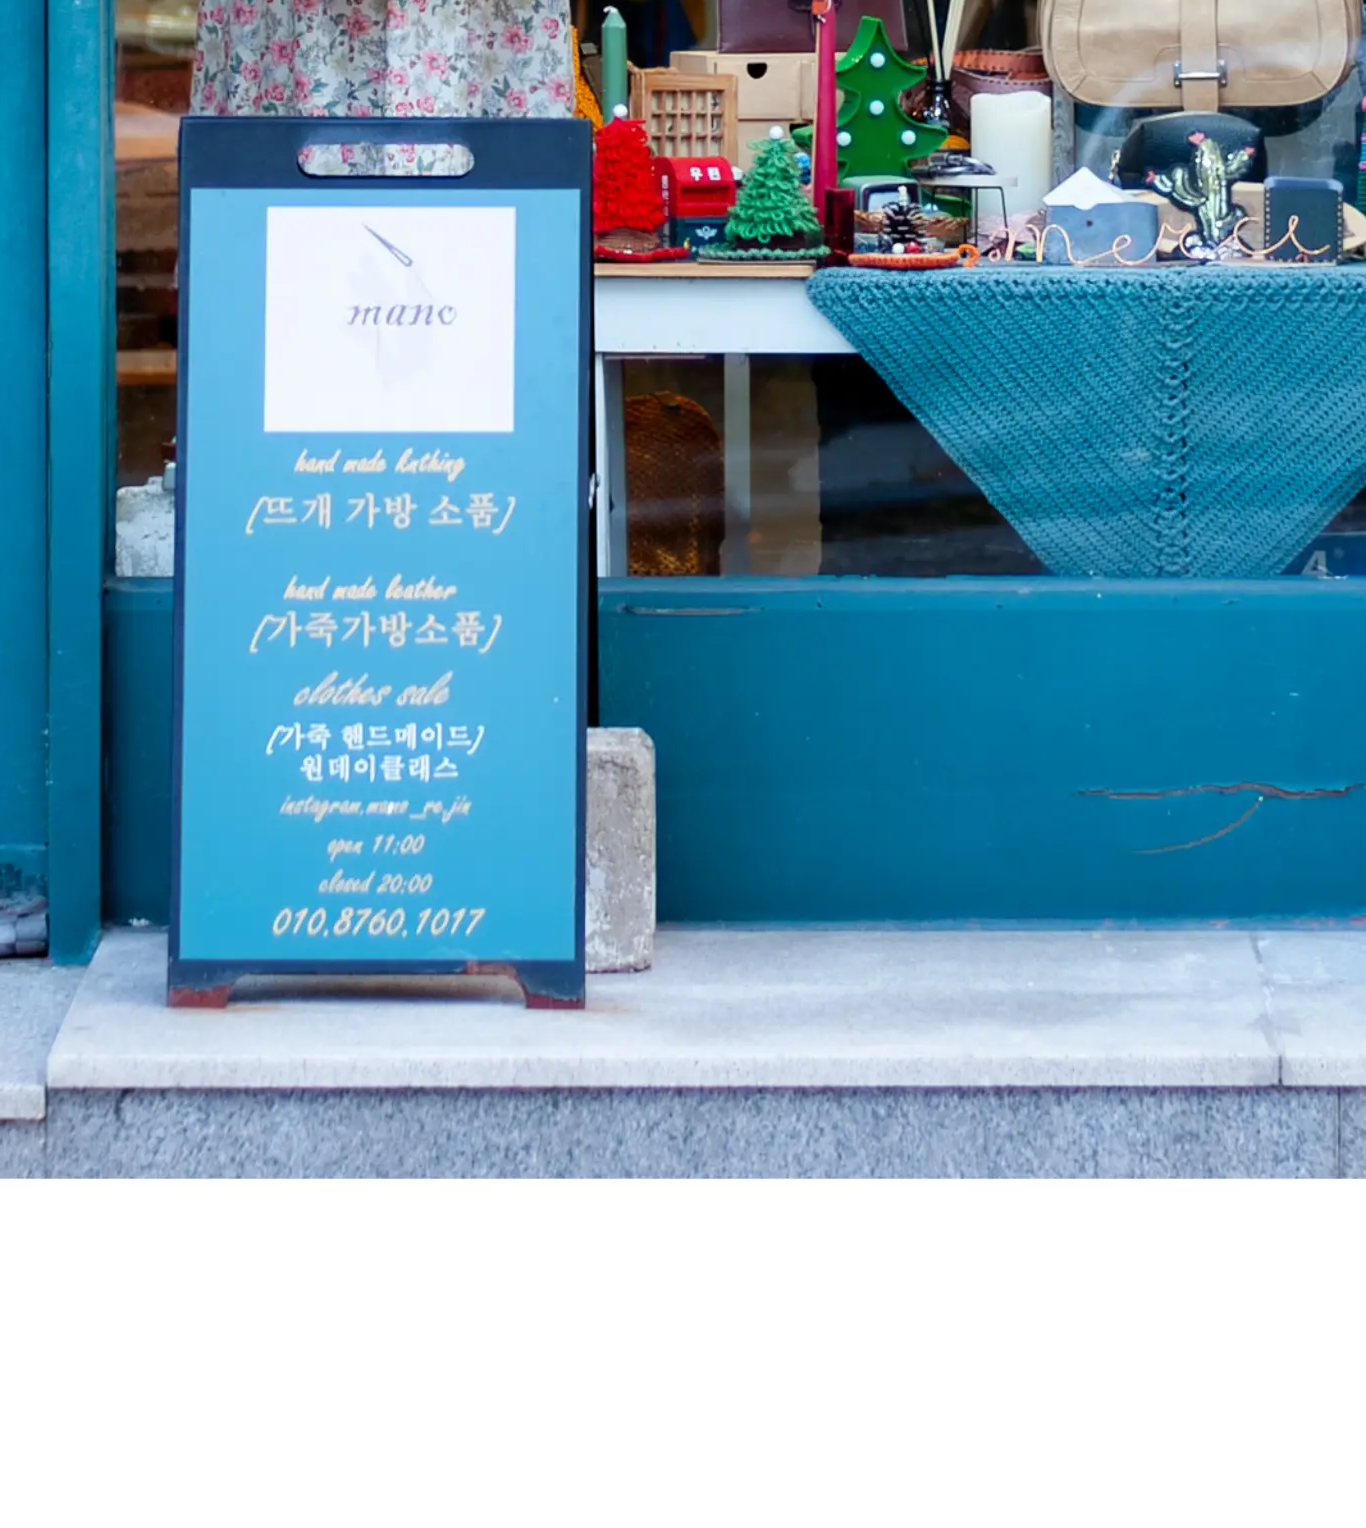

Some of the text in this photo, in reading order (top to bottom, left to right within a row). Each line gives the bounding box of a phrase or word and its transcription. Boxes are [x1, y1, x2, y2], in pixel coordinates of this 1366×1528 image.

[346, 303, 457, 326] mano
[293, 448, 341, 474] hand
[343, 448, 387, 473] made
[346, 492, 418, 529] 가방
[428, 492, 517, 535] 소품)
[284, 573, 457, 601] hand made leather
[292, 670, 454, 706] clothes sale
[300, 753, 459, 783] 원데이클래스
[327, 833, 426, 863] open 11:00
[318, 869, 434, 894] closed 20:00
